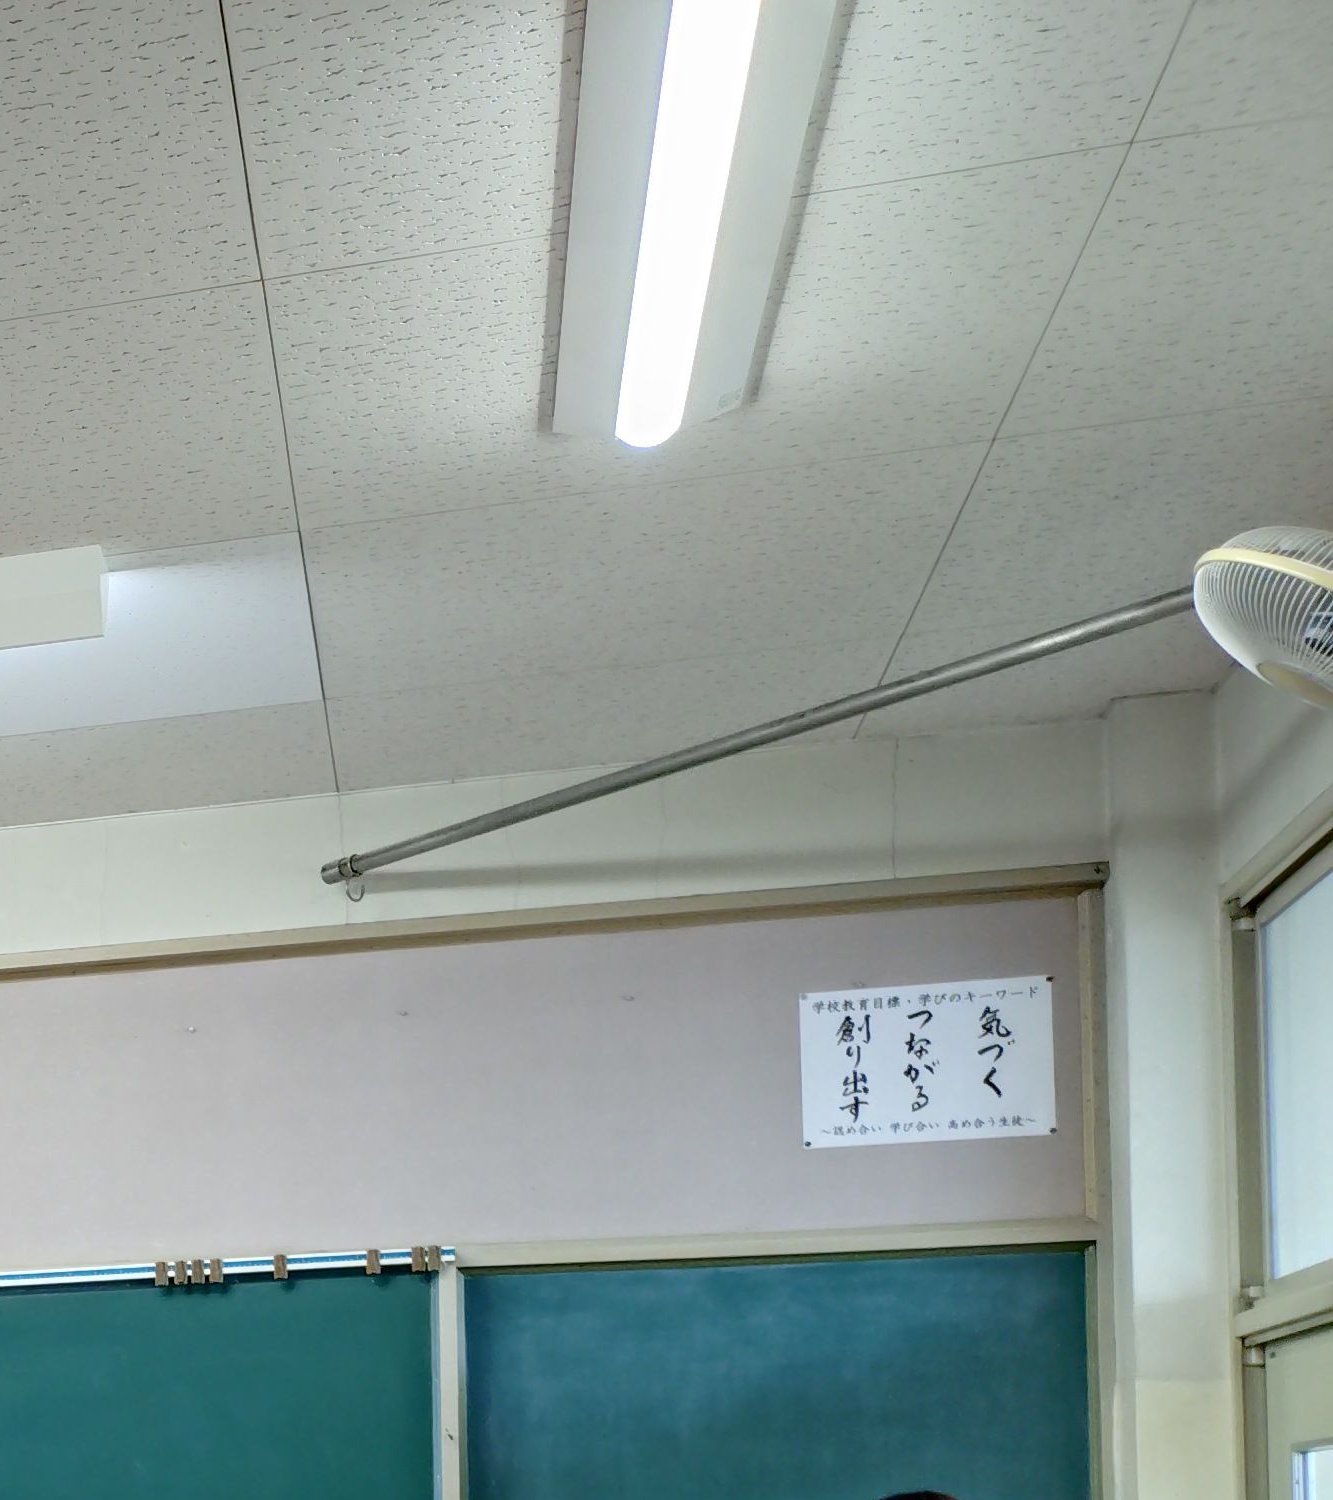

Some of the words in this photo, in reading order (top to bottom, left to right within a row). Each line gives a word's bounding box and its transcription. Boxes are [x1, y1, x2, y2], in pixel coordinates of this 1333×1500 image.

[836, 1014, 872, 1123] 創り出す
[903, 1010, 940, 1112] つながる
[978, 1005, 1016, 1098] 気づく
